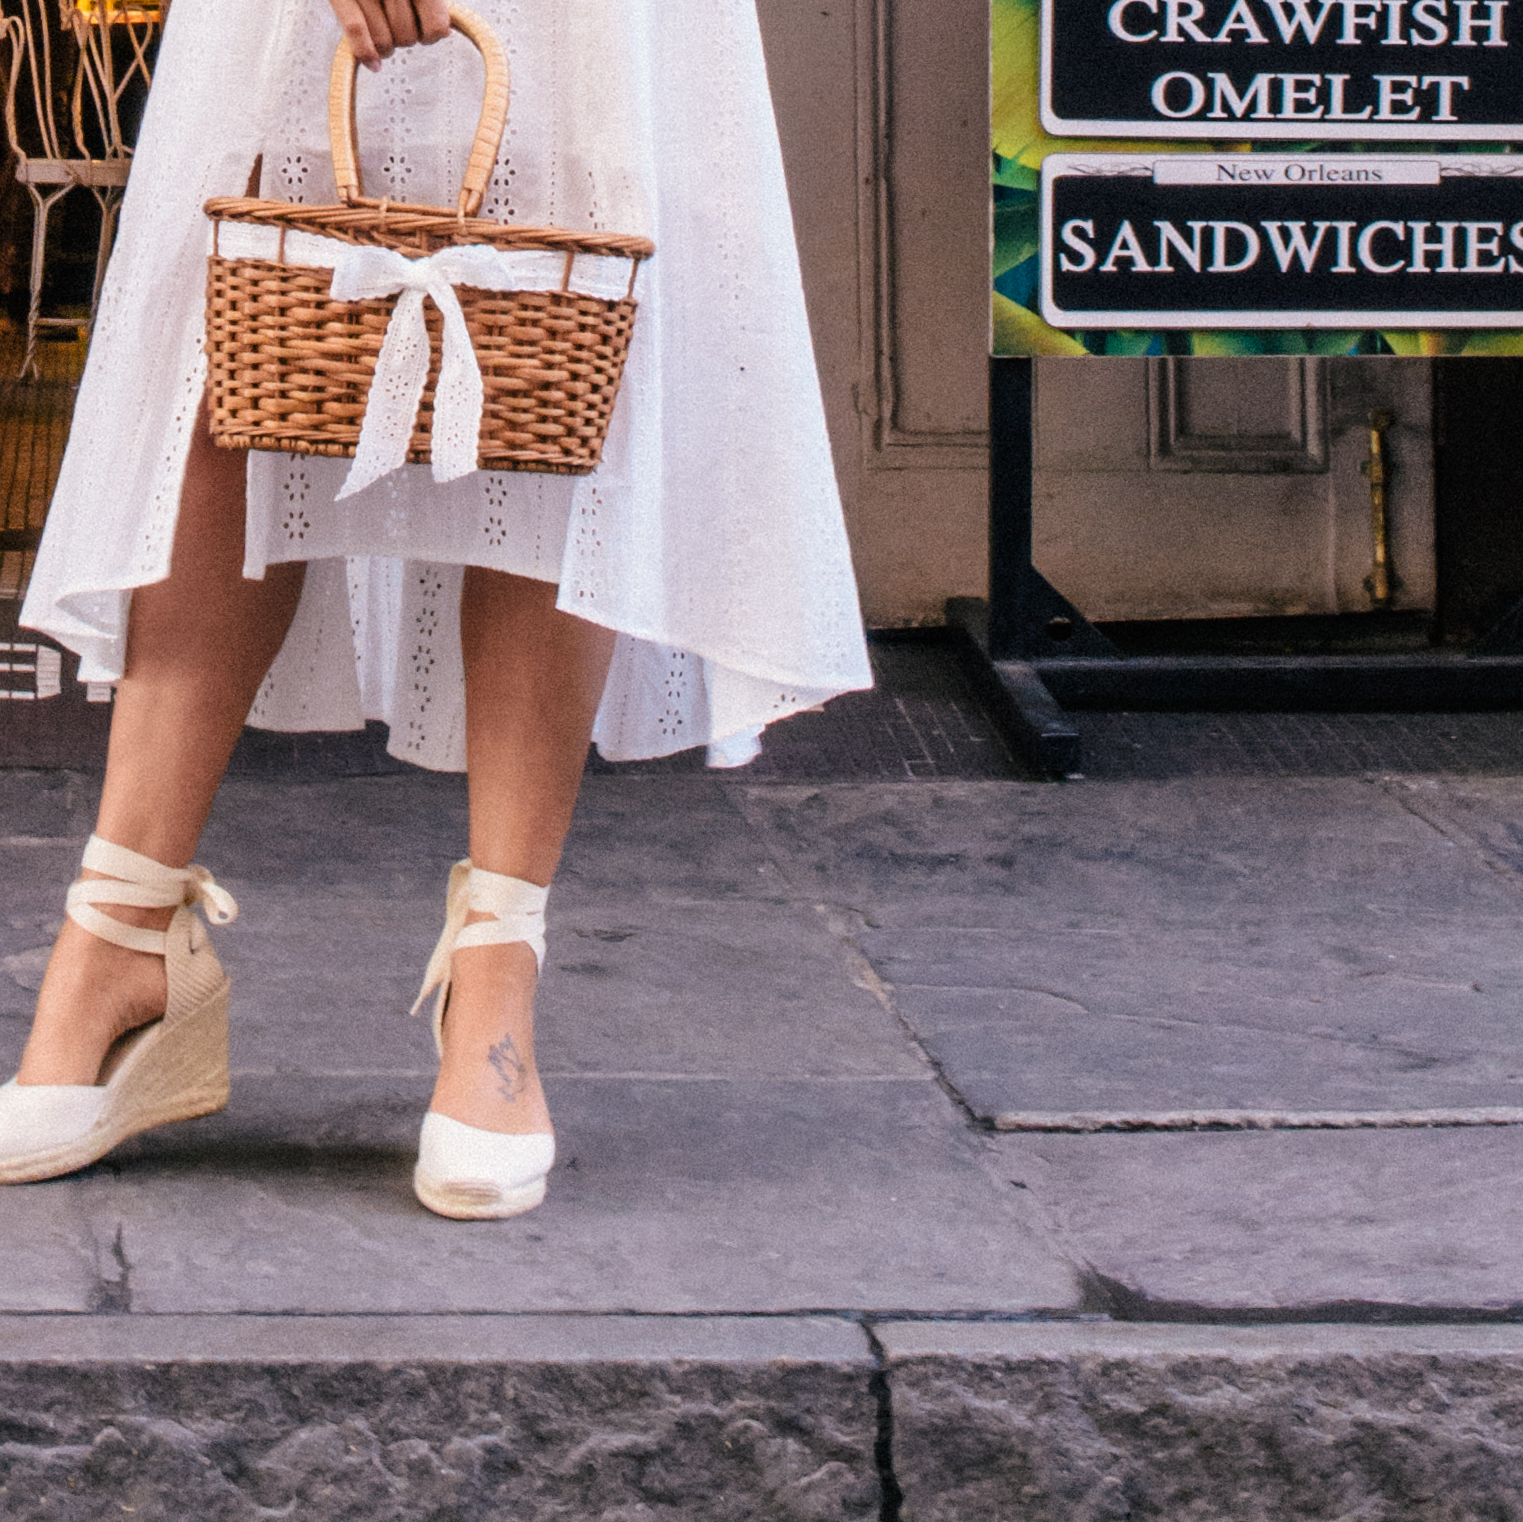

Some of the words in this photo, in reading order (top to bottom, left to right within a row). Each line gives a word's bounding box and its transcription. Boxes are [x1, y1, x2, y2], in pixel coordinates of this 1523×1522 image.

[1151, 71, 1470, 121] OMELET
[1215, 164, 1278, 182] New
[1283, 163, 1383, 183] Orleans
